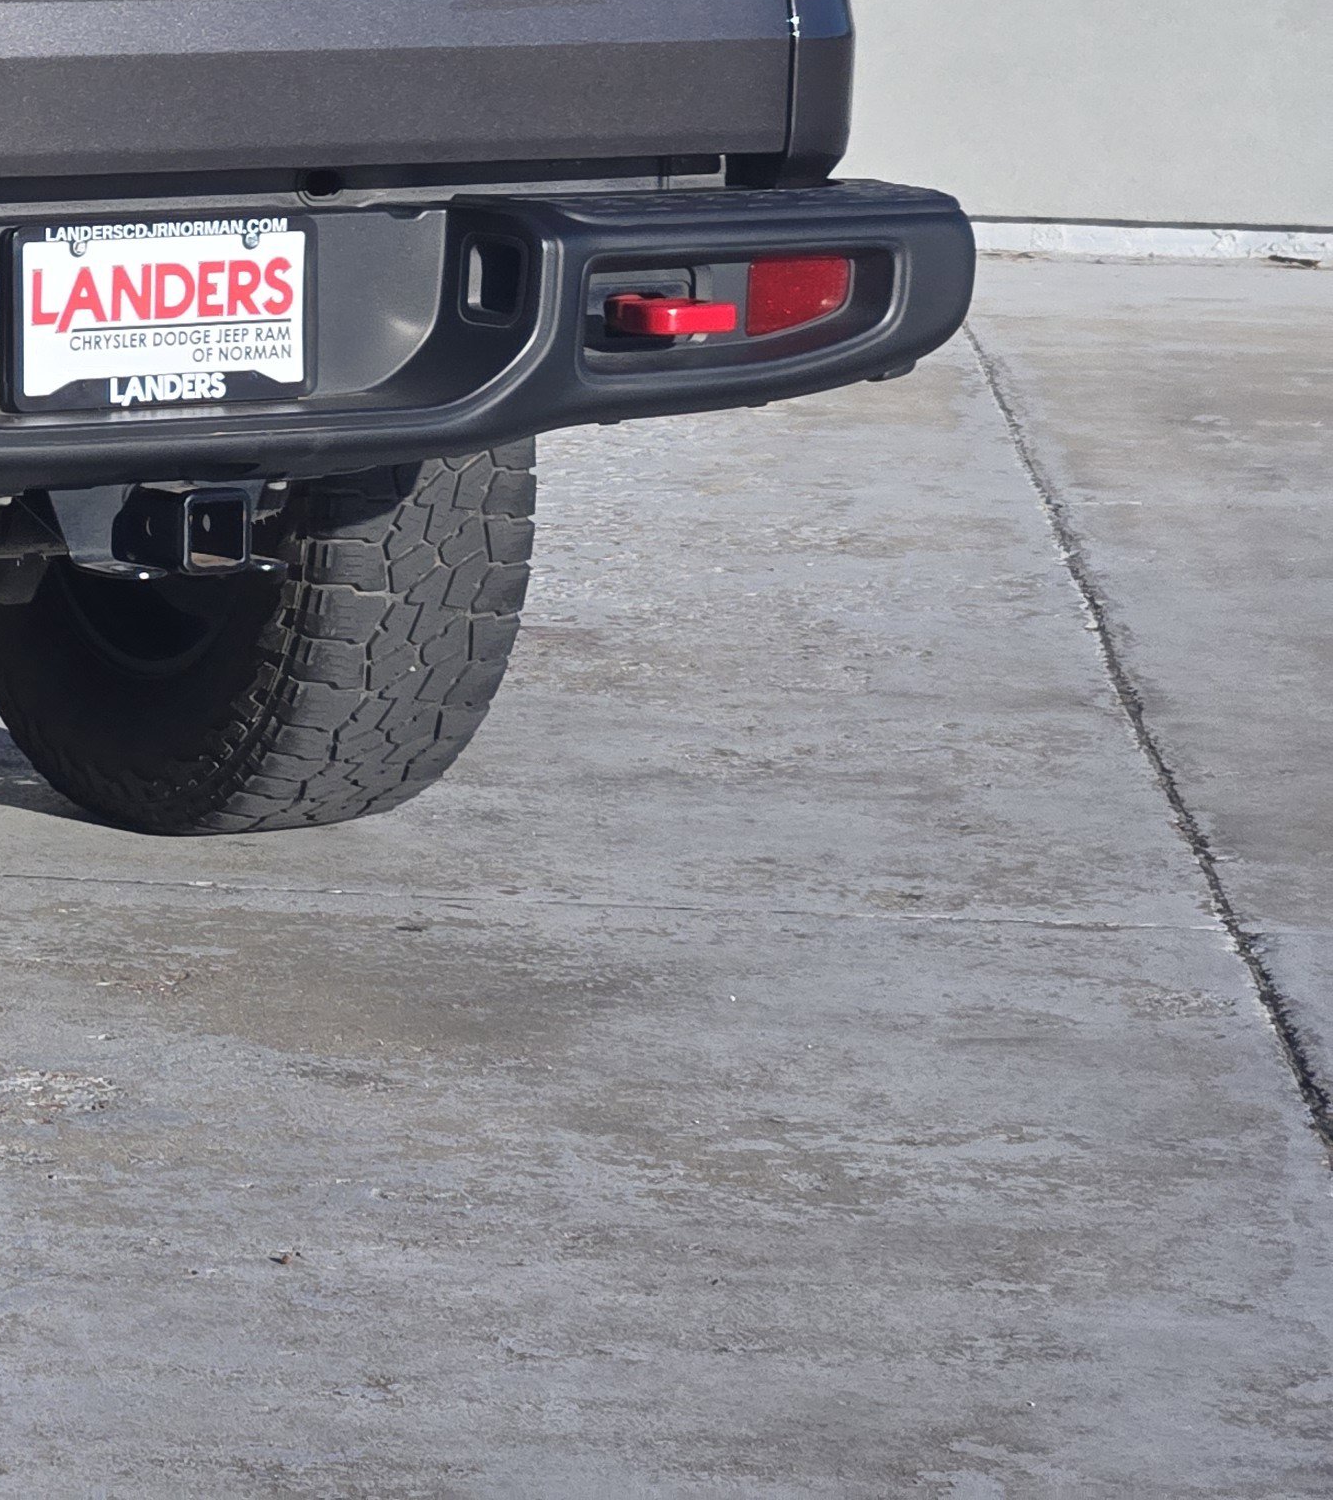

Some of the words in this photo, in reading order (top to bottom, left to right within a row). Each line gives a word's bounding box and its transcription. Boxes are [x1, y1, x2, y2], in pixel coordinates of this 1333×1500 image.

[45, 218, 288, 242] LANDERSCDJRNORMAN.COM
[31, 257, 294, 334] LANDERS
[69, 332, 147, 351] CHRYSLER
[153, 329, 211, 347] DODGE
[215, 328, 250, 344] JEEP
[255, 326, 291, 342] RAM
[192, 347, 214, 362] OF
[218, 344, 291, 361] NORMAN
[110, 373, 226, 406] LANDERS
